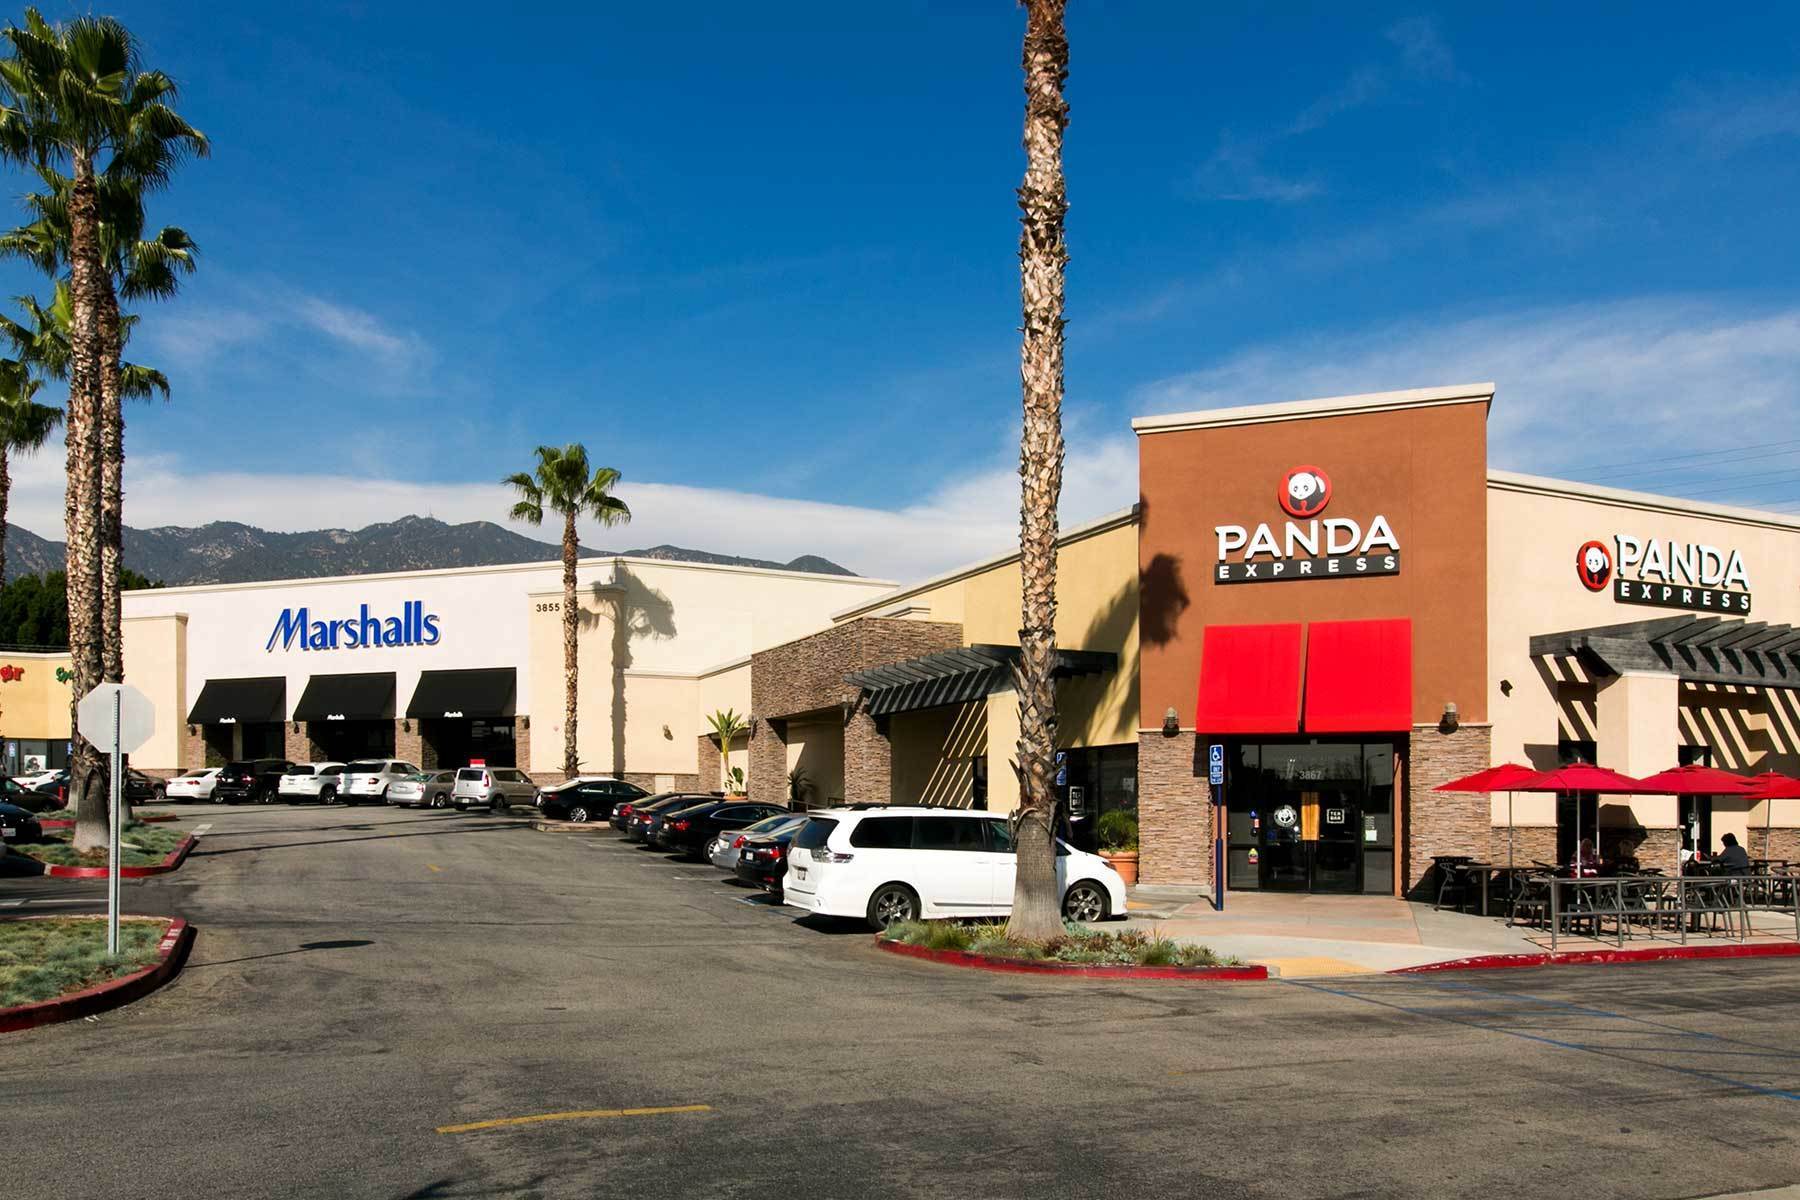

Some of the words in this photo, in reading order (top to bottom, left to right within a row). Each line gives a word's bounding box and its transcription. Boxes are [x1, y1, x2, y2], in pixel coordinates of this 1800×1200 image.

[1215, 515, 1400, 561] PANDA
[1219, 556, 1396, 579] EXPRESS
[1615, 534, 1750, 591] PANDA
[536, 603, 560, 612] 3855
[1621, 582, 1749, 610] EXPRESS
[265, 600, 441, 653] Marshalls
[1299, 770, 1322, 780] 3867
